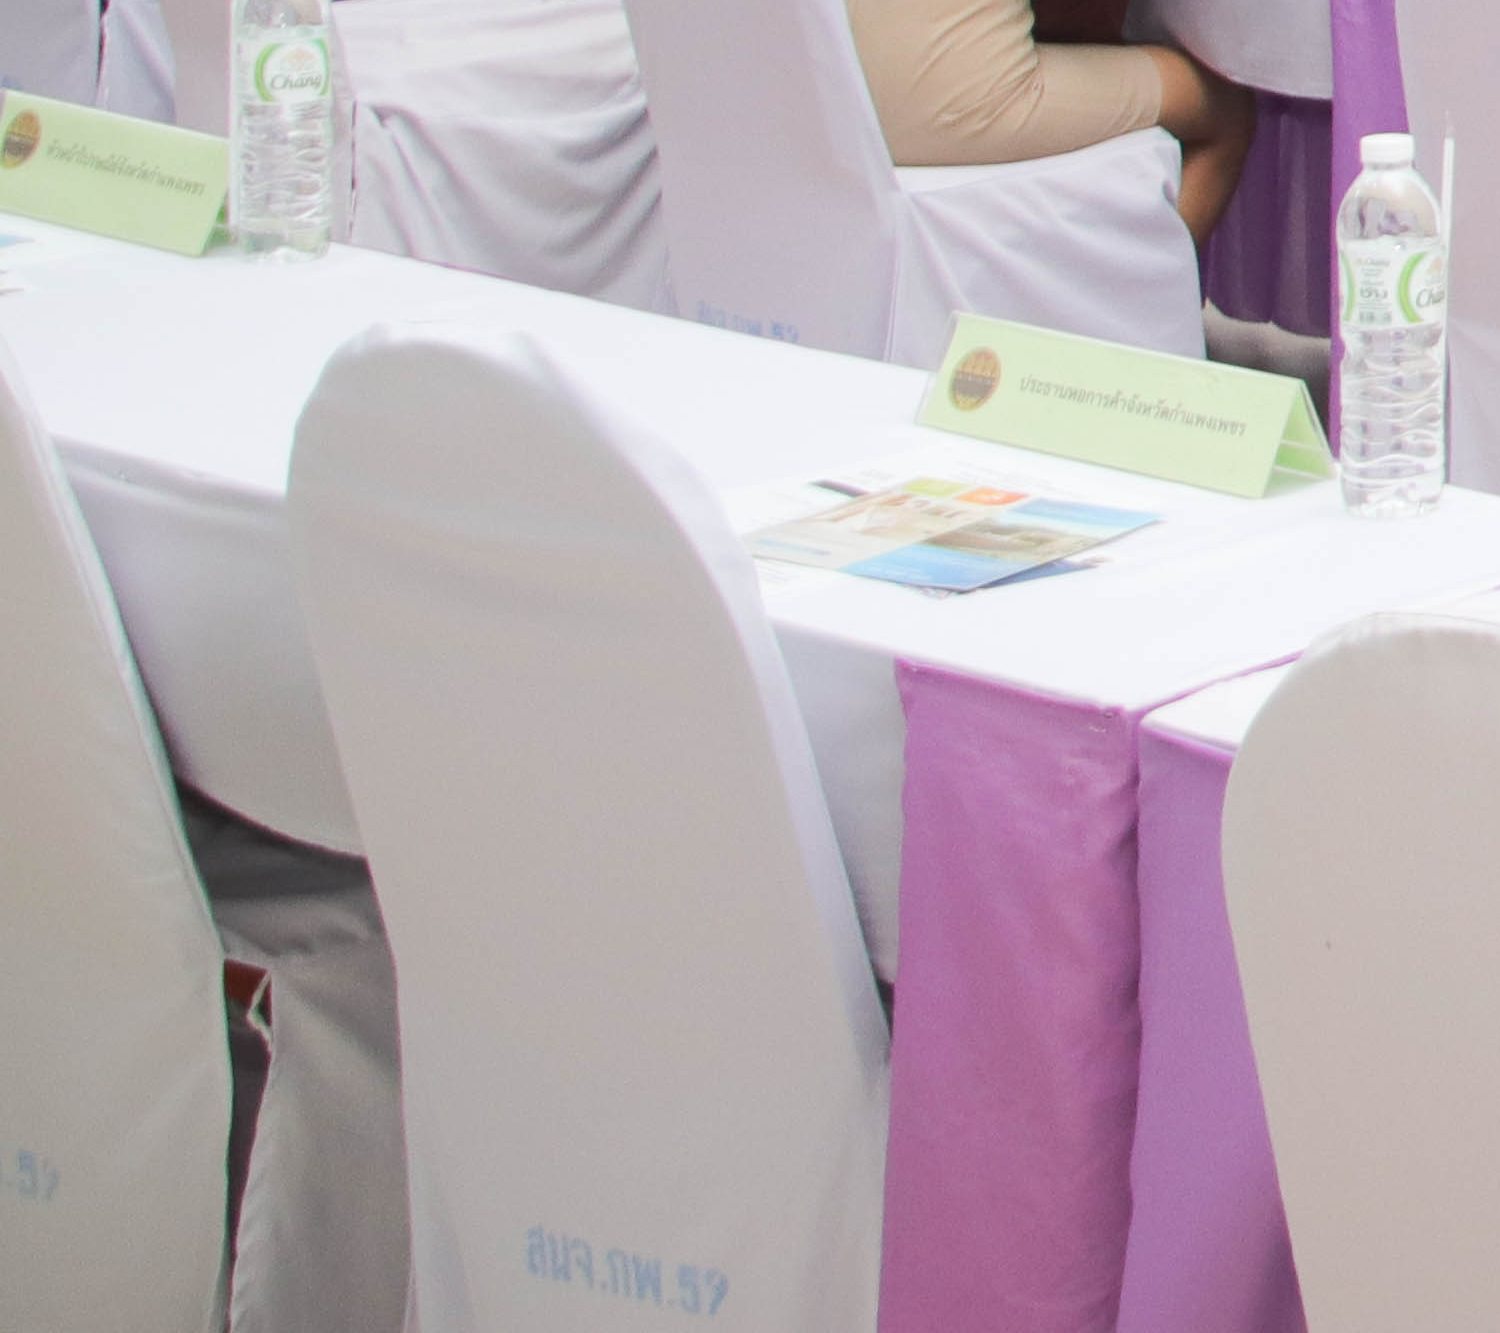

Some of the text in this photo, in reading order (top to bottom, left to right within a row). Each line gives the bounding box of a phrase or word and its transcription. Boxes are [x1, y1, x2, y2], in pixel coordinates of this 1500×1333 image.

[268, 71, 323, 93] Chang
[1019, 373, 1248, 437] ประธานหอการค้าจังหวัดกำแพงเพชร
